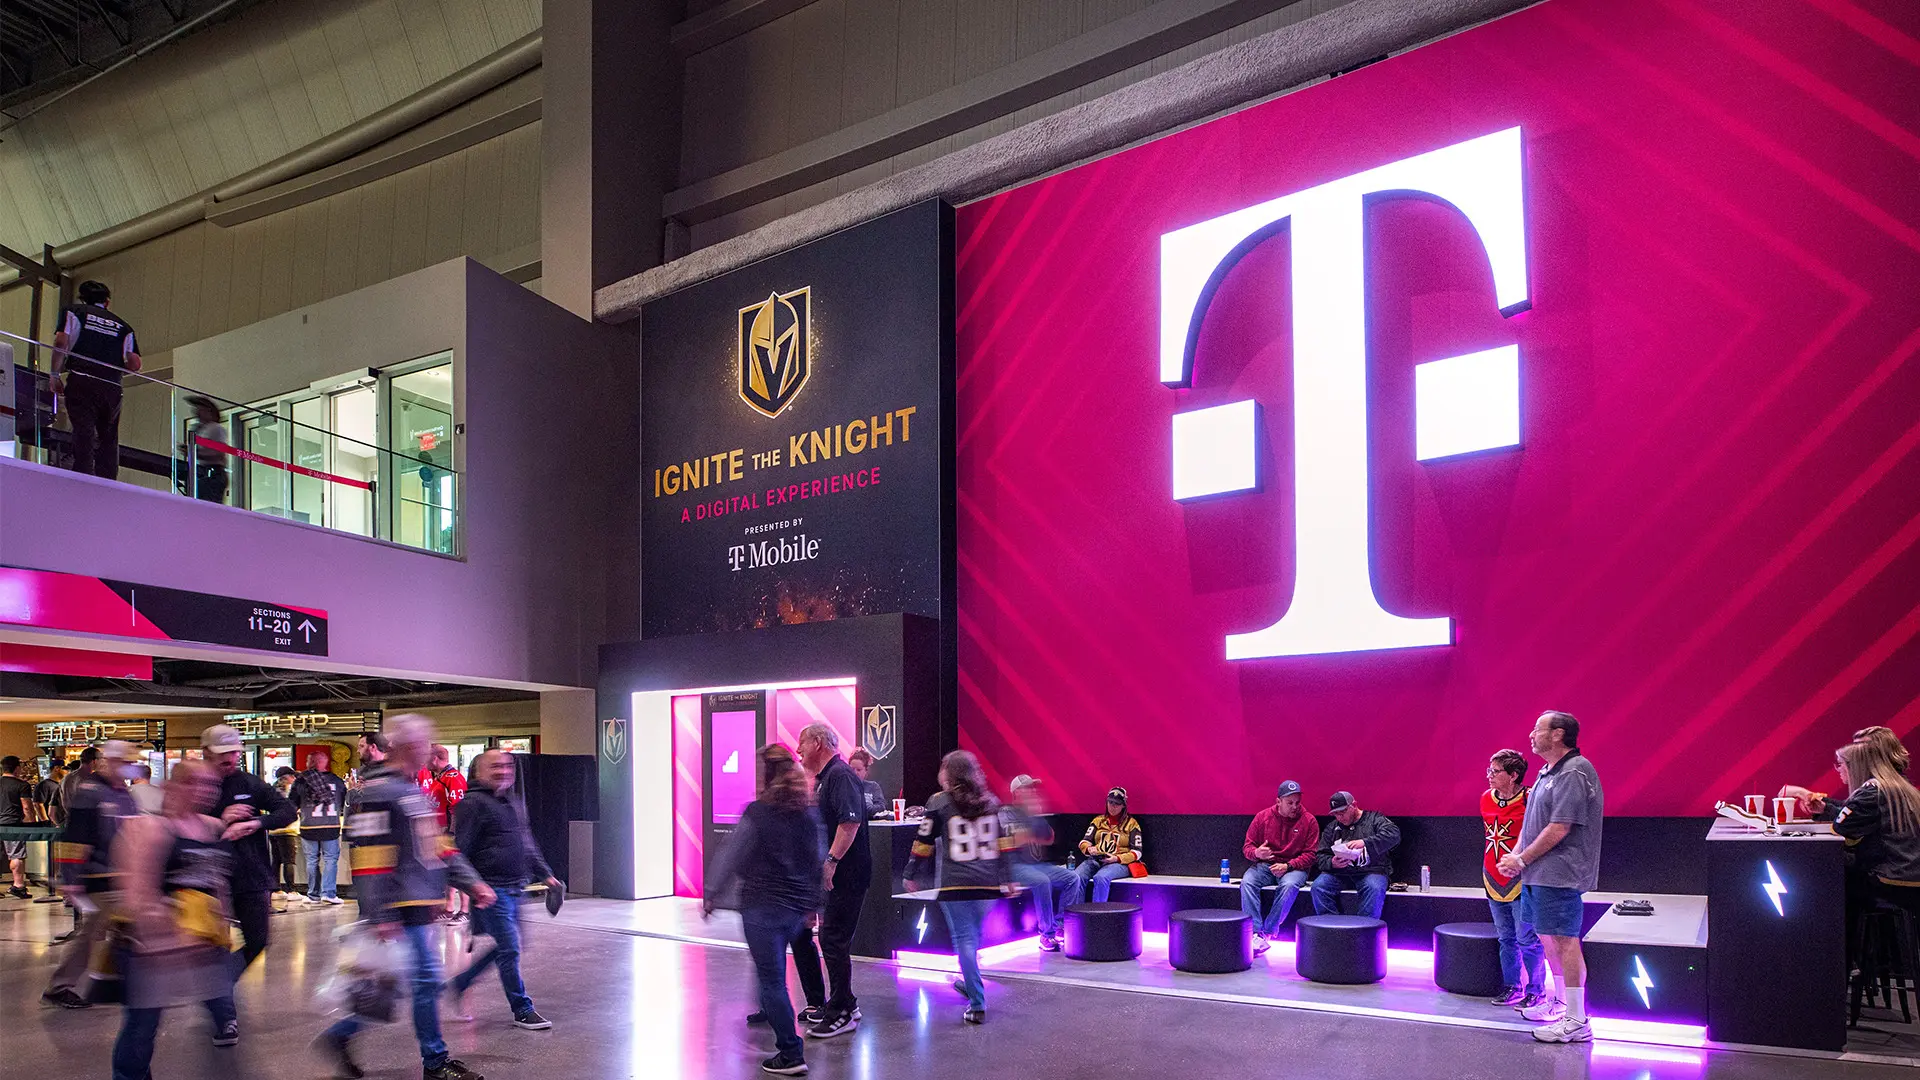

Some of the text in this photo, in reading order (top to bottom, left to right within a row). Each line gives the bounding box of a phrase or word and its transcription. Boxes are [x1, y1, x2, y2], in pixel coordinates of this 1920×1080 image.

[86, 313, 124, 329] BEST
[654, 406, 917, 498] IGNITE THE KNIGHT
[681, 466, 881, 524] A DIGITAL EXPERIENCE
[744, 517, 804, 536] PRESENTED BY
[748, 534, 820, 569] Mobile
[253, 607, 291, 620] SECTIONS
[274, 637, 292, 646] EXIT
[48, 723, 118, 742] LIT UP
[243, 713, 329, 735] LIT UP
[450, 789, 465, 800] 43
[948, 815, 999, 862] 89
